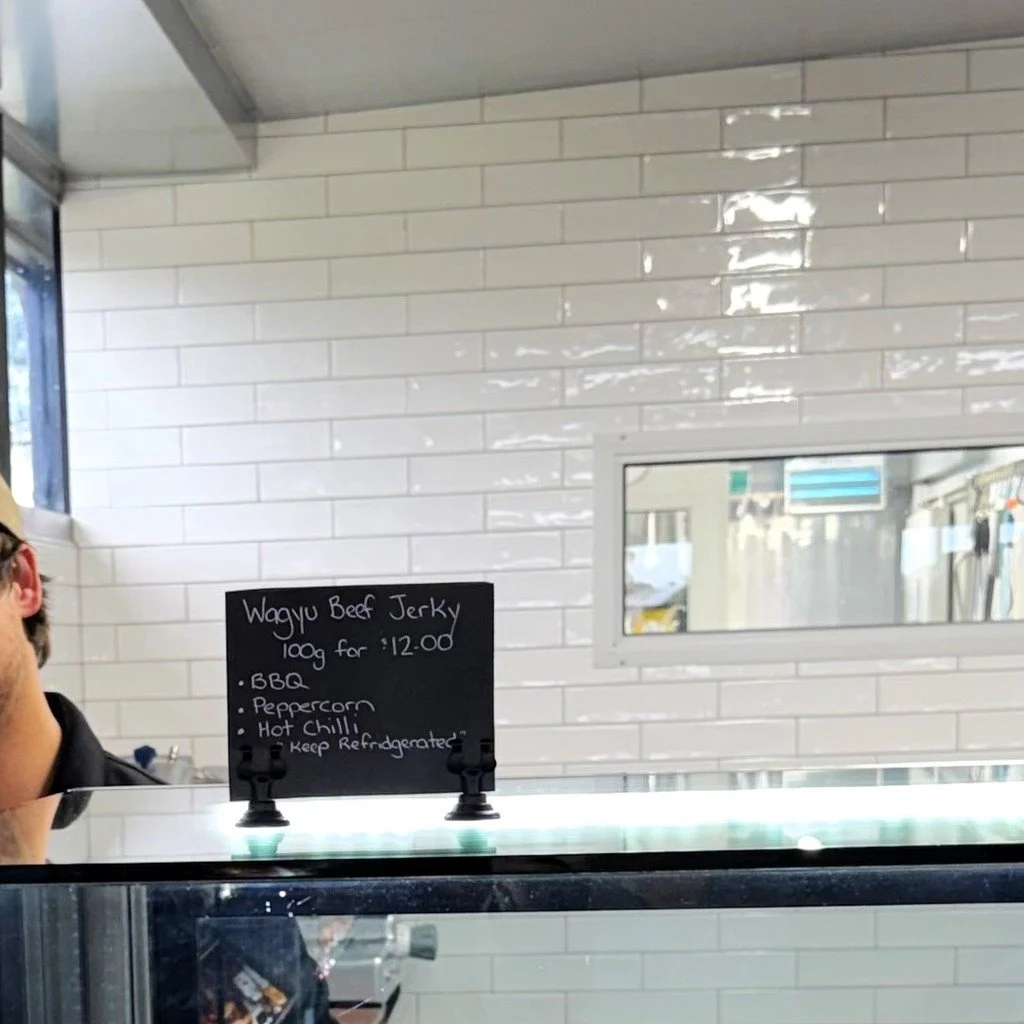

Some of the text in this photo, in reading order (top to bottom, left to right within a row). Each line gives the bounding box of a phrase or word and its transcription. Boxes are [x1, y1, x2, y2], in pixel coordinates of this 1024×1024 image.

[242, 594, 460, 640] Wagyu Beef Jerky
[283, 643, 325, 670] 100g
[335, 639, 367, 658] for
[251, 673, 310, 690] BBQ
[253, 697, 375, 718] Peppercorn
[258, 716, 358, 738] Hot Chilli
